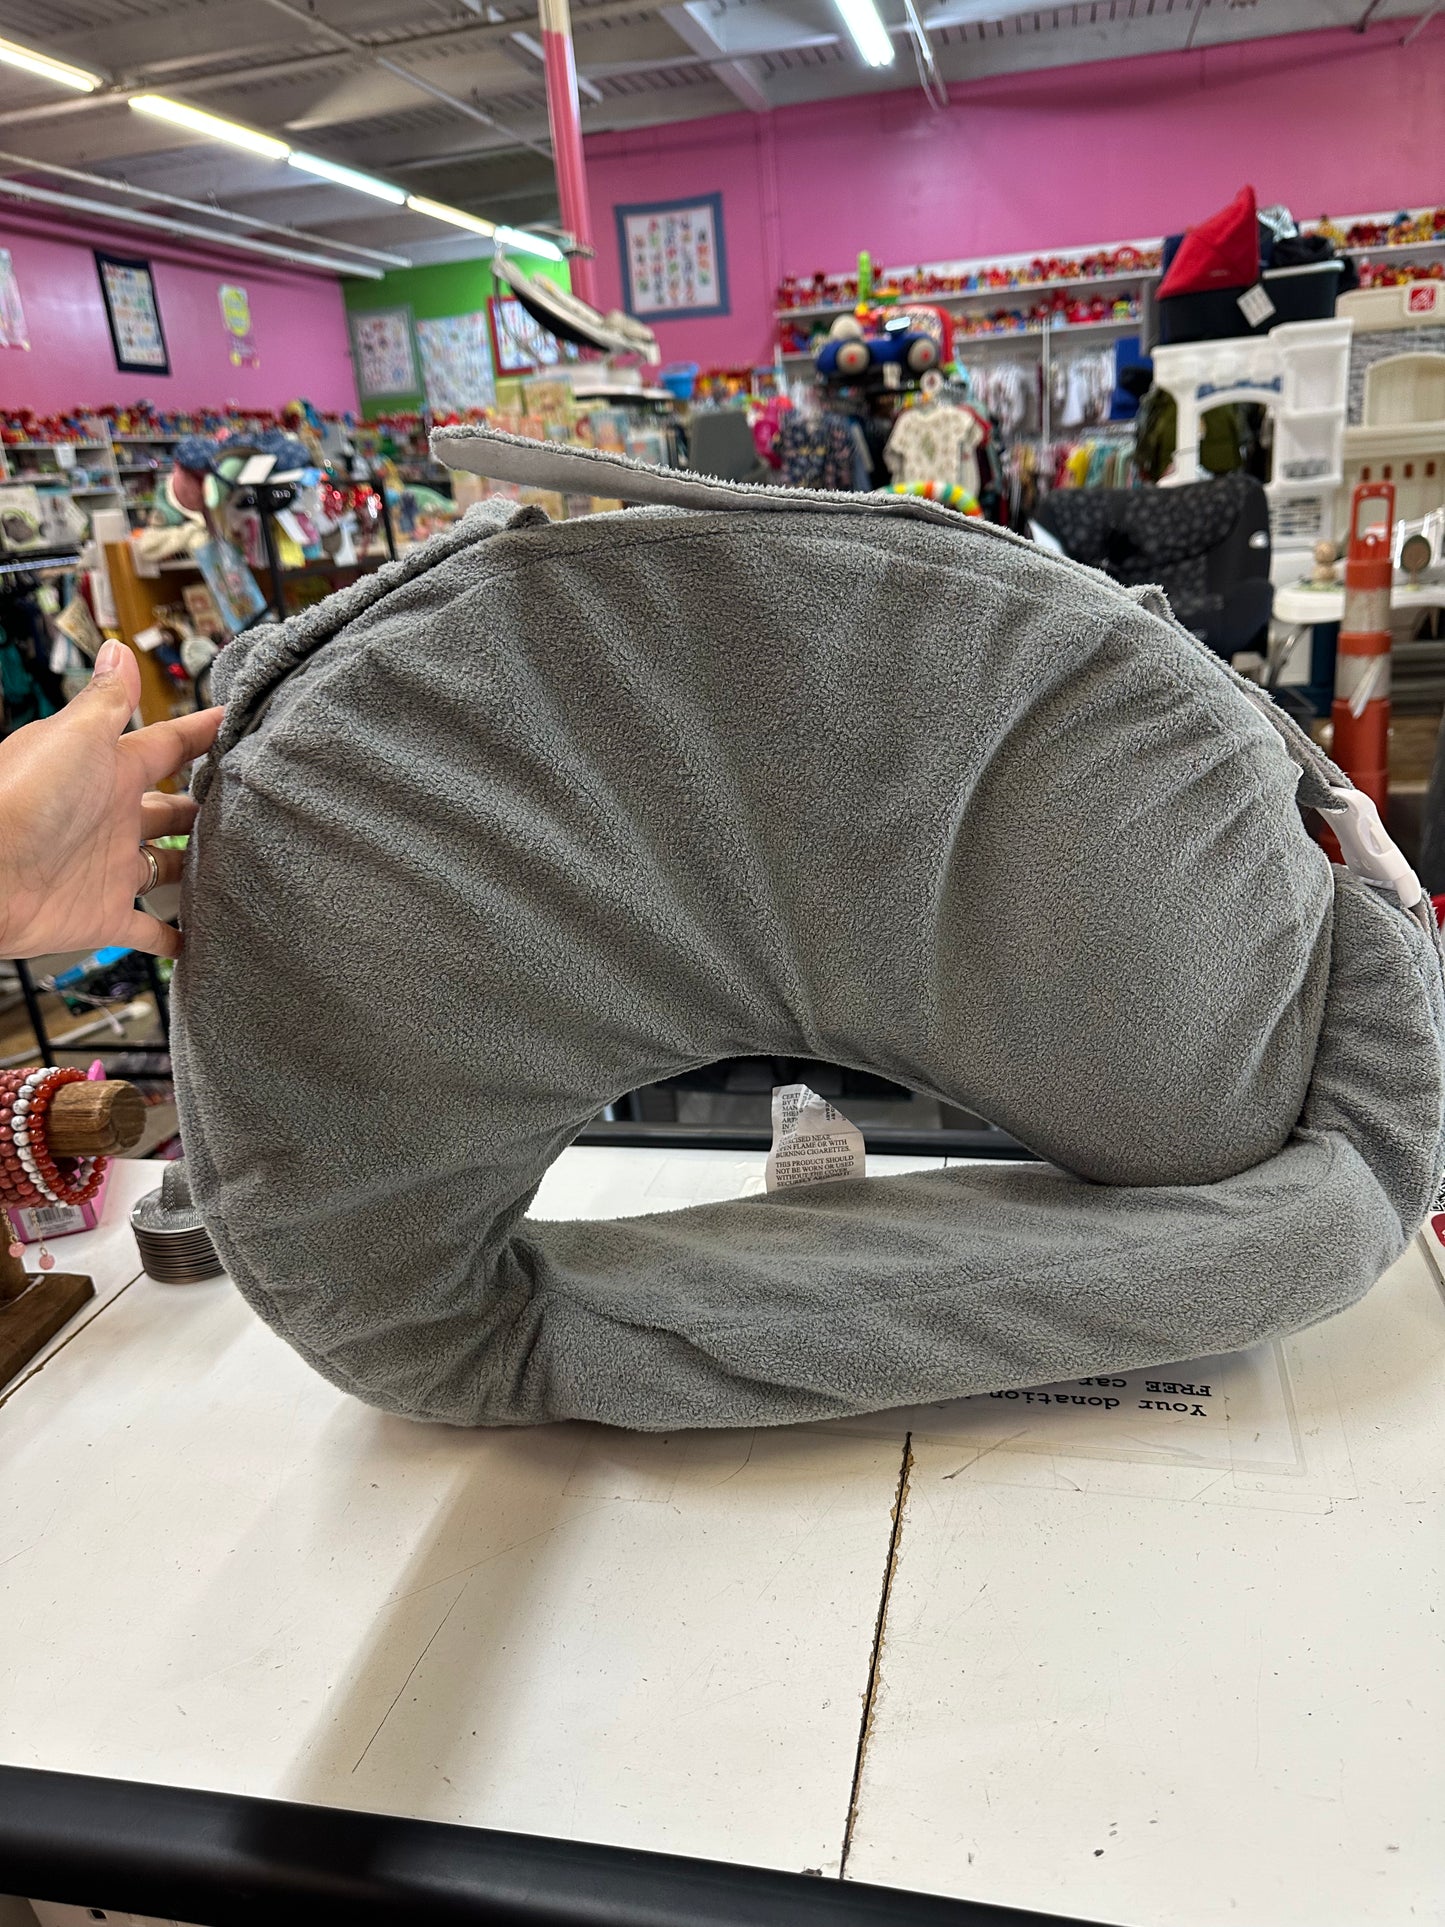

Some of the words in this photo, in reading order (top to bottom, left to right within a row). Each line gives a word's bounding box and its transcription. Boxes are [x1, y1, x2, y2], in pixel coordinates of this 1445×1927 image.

[812, 1134, 832, 1142] NEAR
[793, 1142, 816, 1150] FLAME
[775, 1150, 806, 1159] BURNING
[792, 1158, 824, 1167] PRODUCT
[825, 1155, 854, 1164] SHOULD
[802, 1164, 824, 1172] WORN
[776, 1173, 809, 1181] WITHOUT
[1078, 1377, 1127, 1388] car
[1145, 1380, 1212, 1397] FREE
[989, 1390, 1121, 1410] donation
[1138, 1399, 1207, 1417] Your
